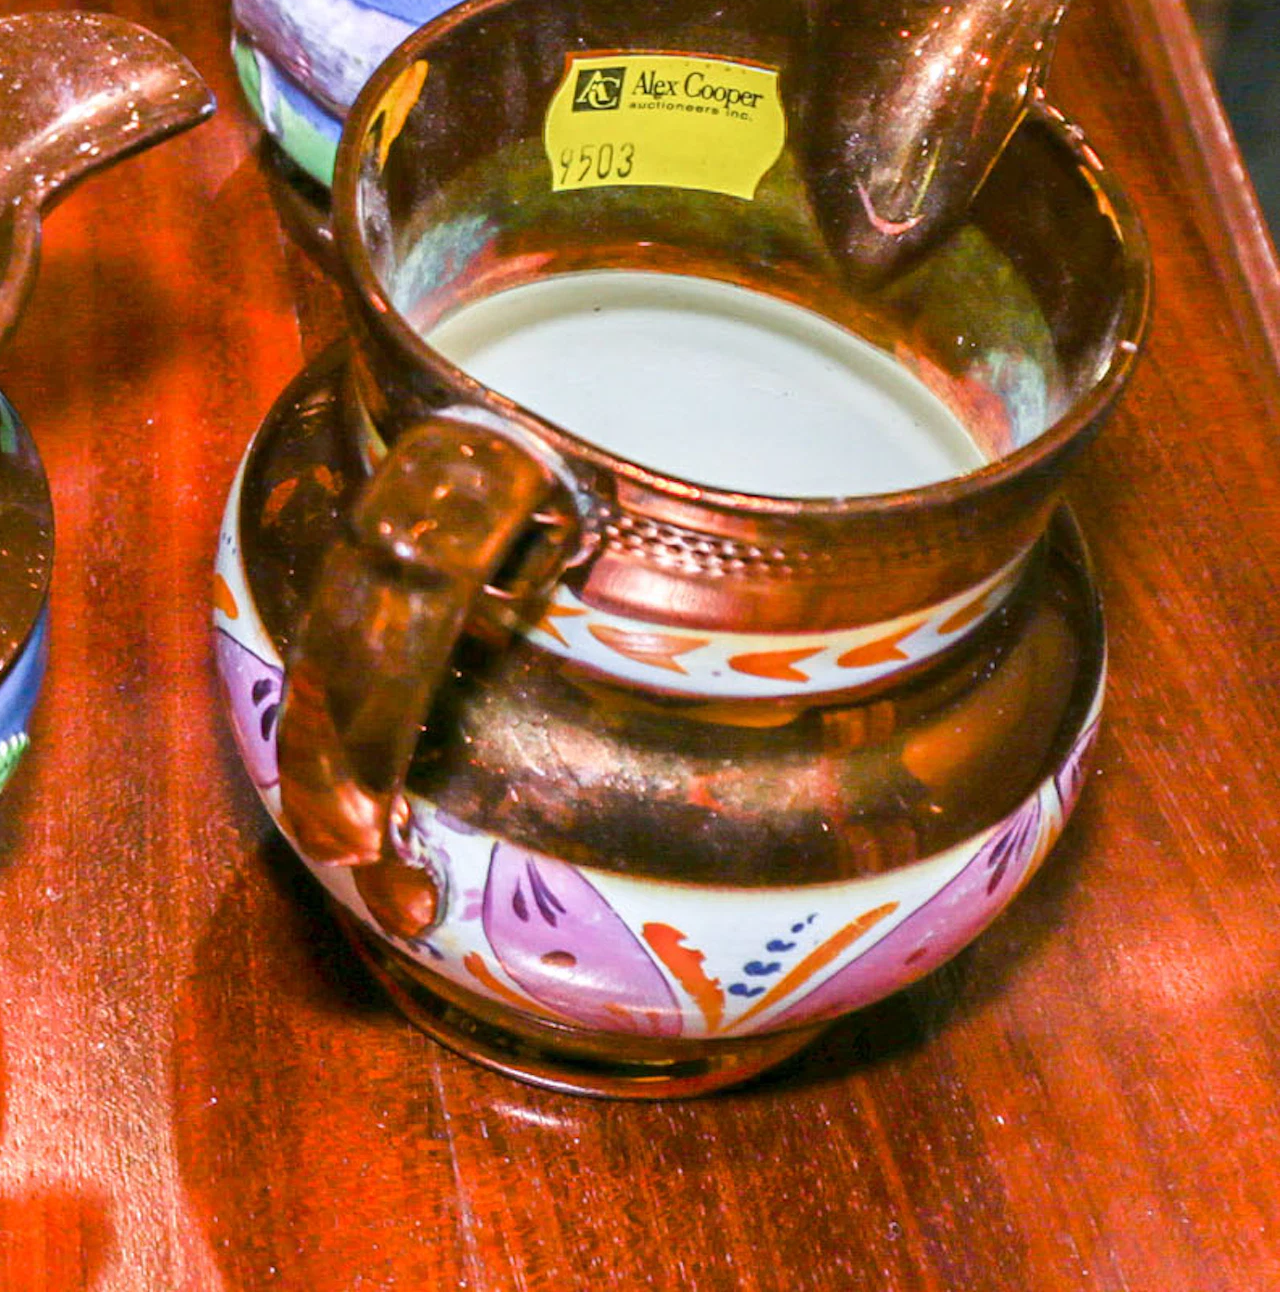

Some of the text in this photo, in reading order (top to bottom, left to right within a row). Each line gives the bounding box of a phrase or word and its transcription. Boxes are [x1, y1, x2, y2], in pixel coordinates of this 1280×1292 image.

[632, 69, 764, 109] Alex Cooper
[629, 101, 753, 122] auctioneers inc.
[560, 142, 635, 184] 9503
